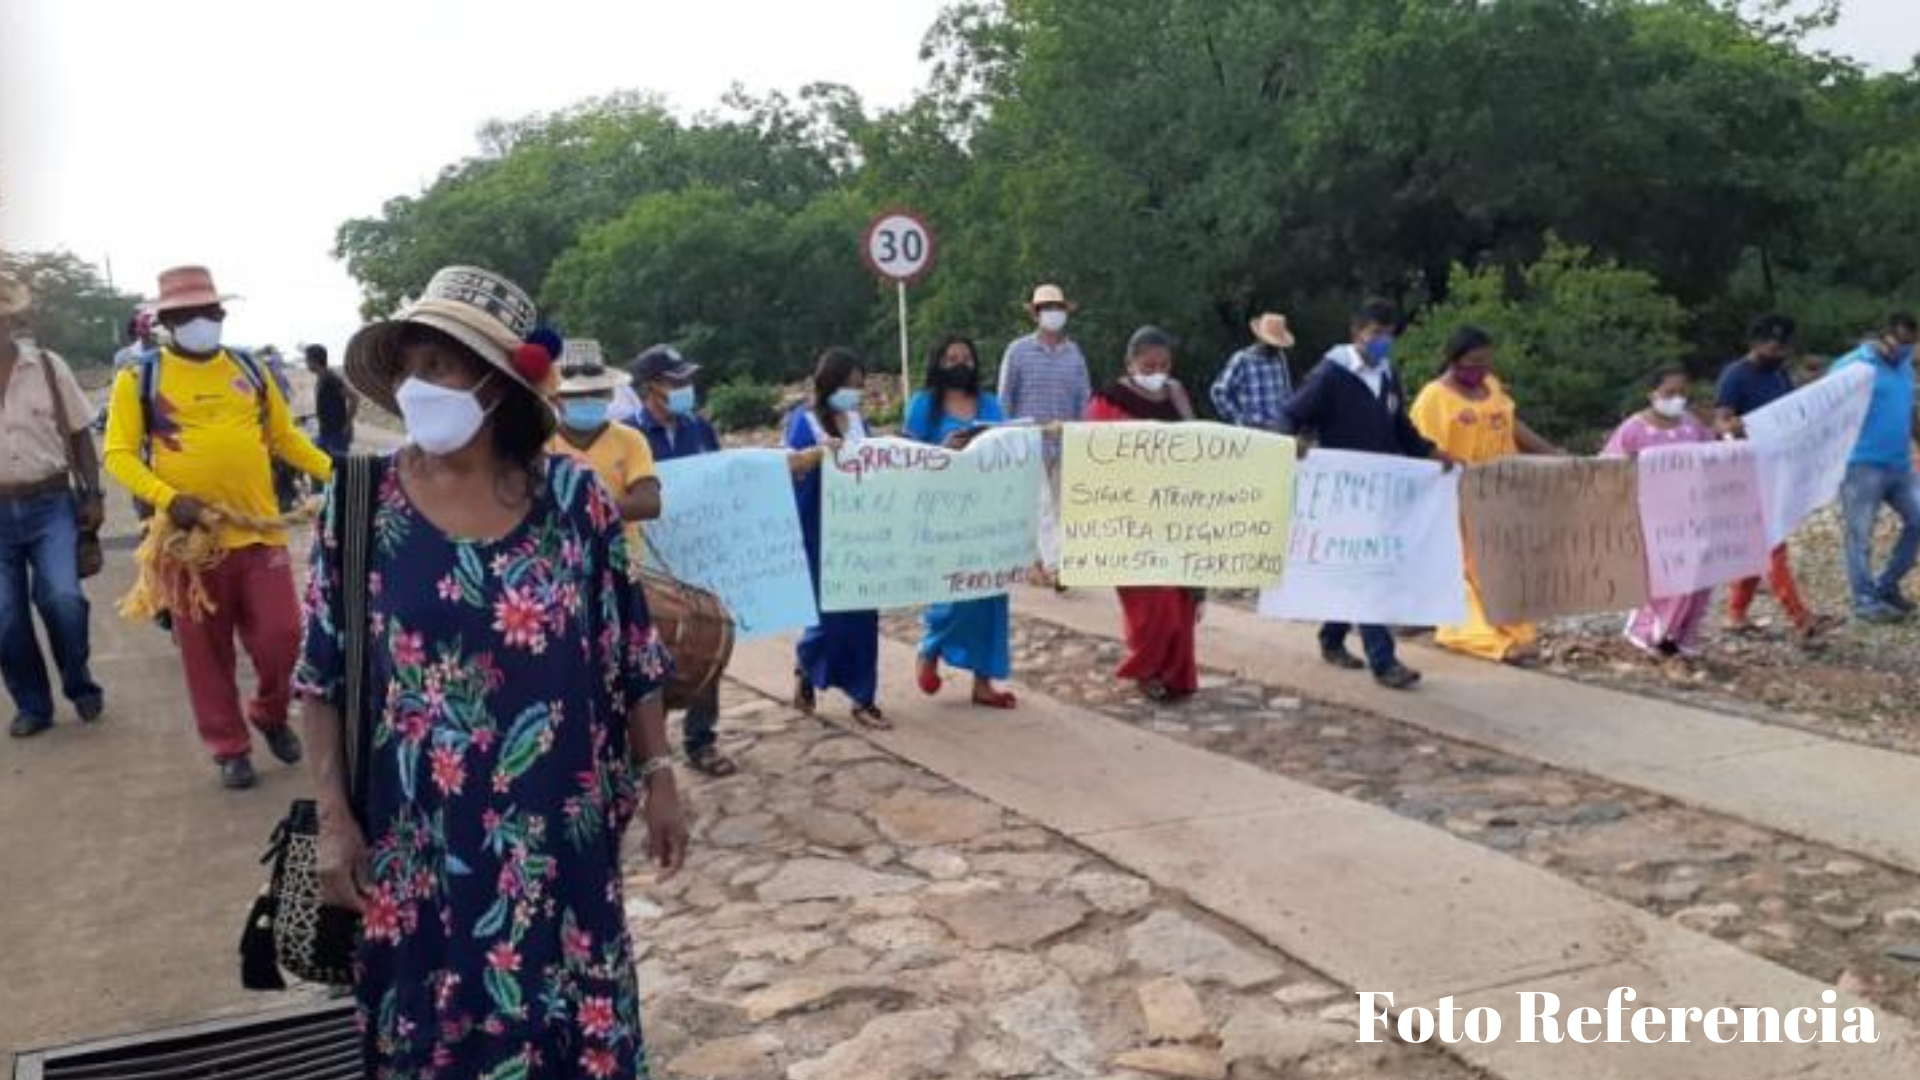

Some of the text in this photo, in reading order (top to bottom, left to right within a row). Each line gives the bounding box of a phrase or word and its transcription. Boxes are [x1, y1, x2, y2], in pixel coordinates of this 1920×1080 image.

[879, 229, 922, 263] 30
[835, 443, 951, 484] GRACIAS
[1087, 428, 1250, 465] CERREJON
[1064, 515, 1152, 540] NUESTRA
